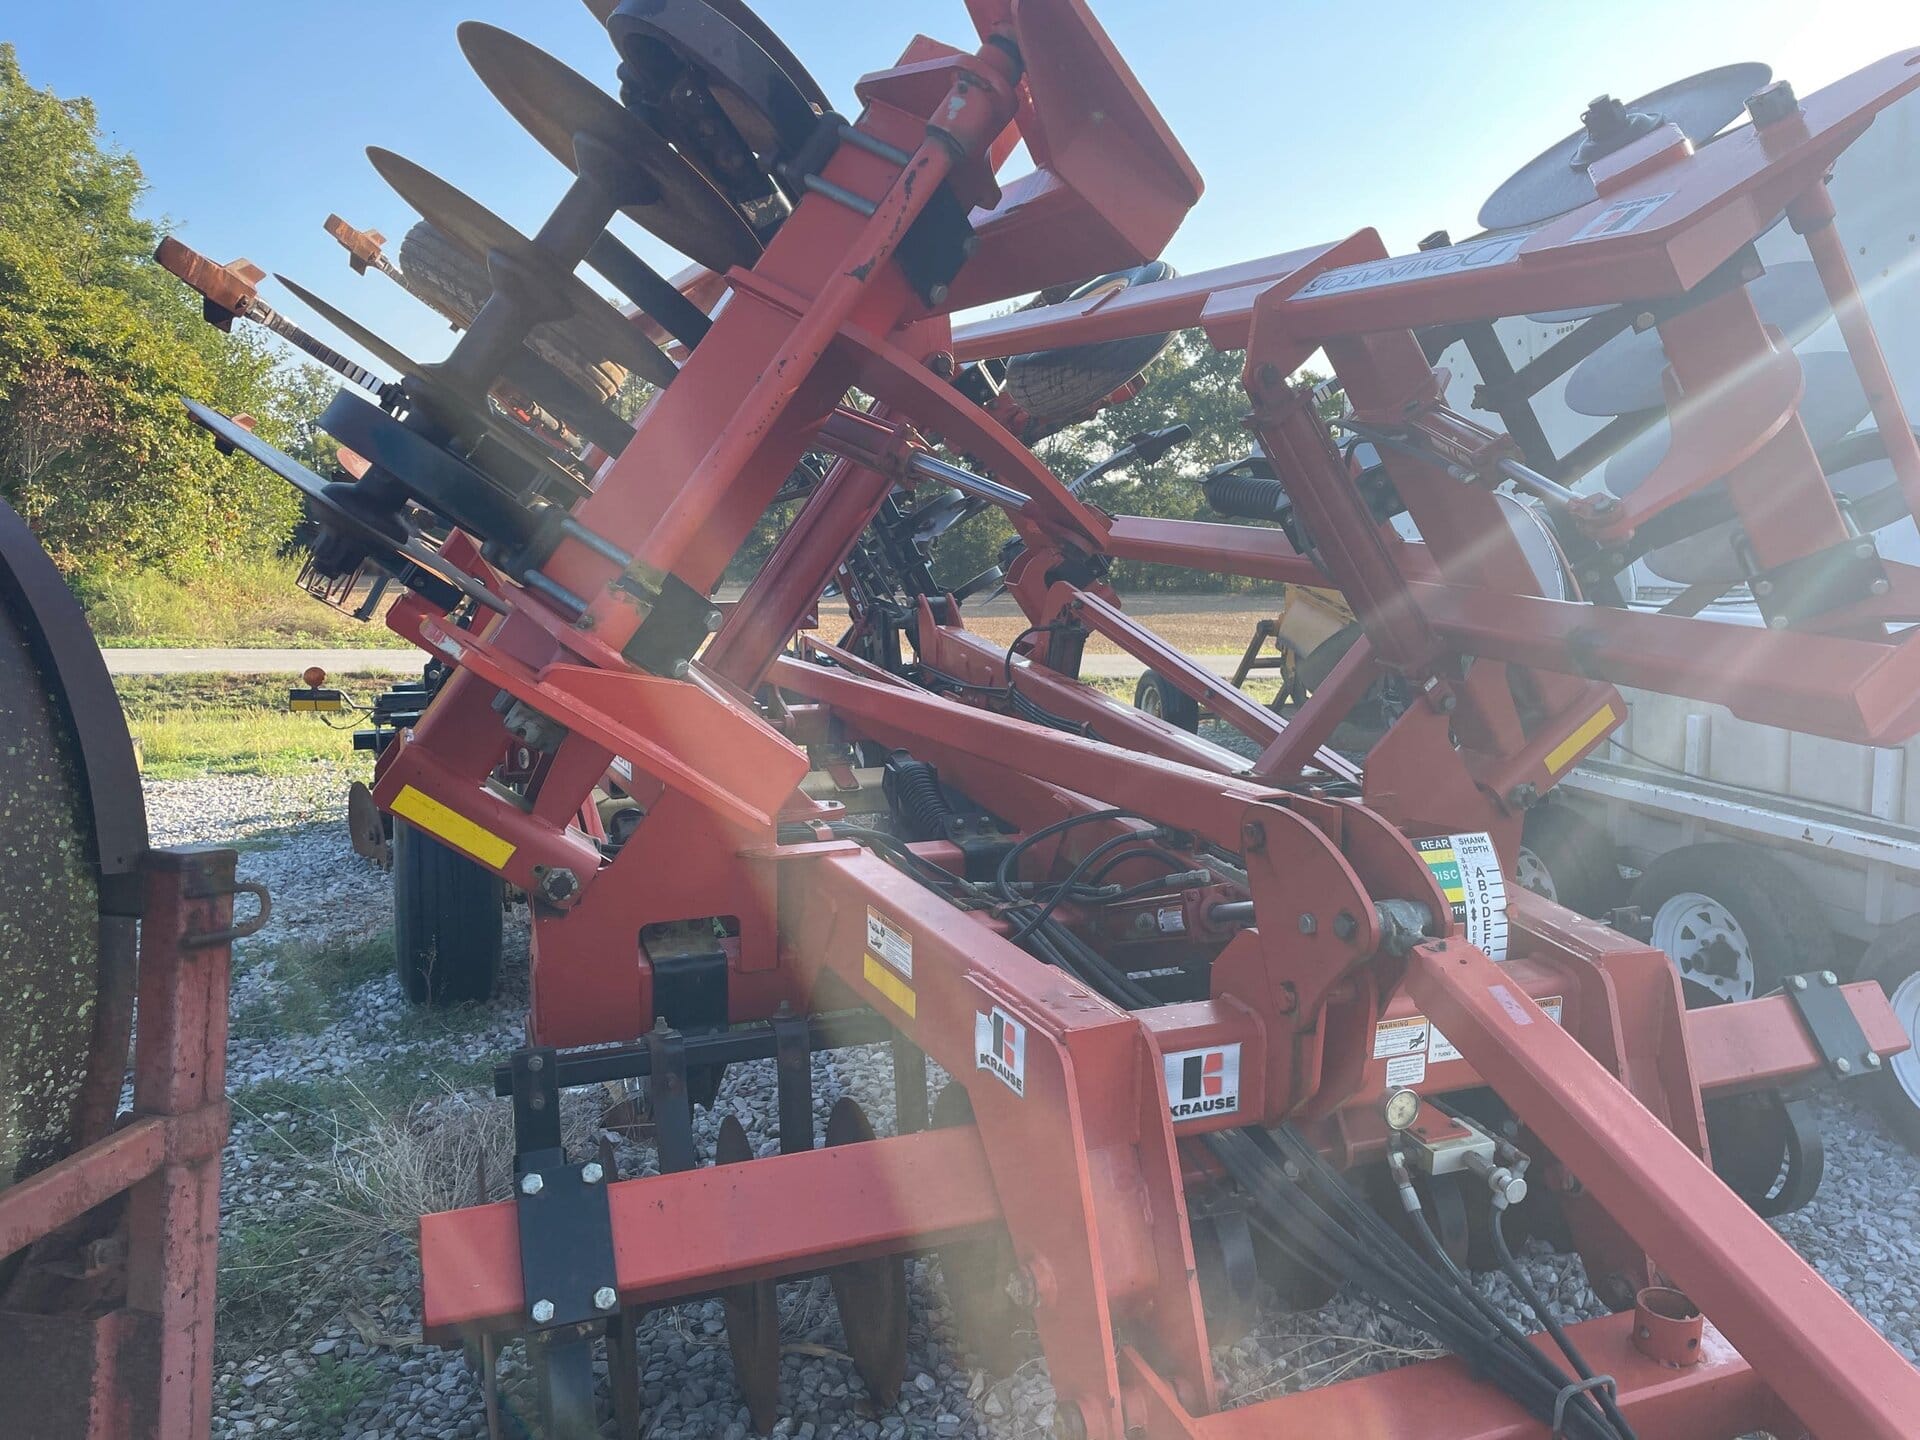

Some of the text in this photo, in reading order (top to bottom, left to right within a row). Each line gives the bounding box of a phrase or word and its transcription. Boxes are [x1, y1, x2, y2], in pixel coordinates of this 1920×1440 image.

[1304, 236, 1528, 293] DOMINATOR
[1420, 839, 1450, 850] REAR
[1459, 836, 1487, 845] SHANK
[1462, 846, 1489, 854] DEPTH
[1476, 867, 1485, 878] A
[1478, 880, 1487, 891] B
[1480, 893, 1489, 904] C
[1482, 907, 1490, 918] D
[1483, 920, 1491, 931] E
[1484, 933, 1491, 944] F
[1482, 946, 1491, 957] G
[980, 1053, 1023, 1092] KRAUSE
[1169, 1096, 1236, 1117] KRAUSE
